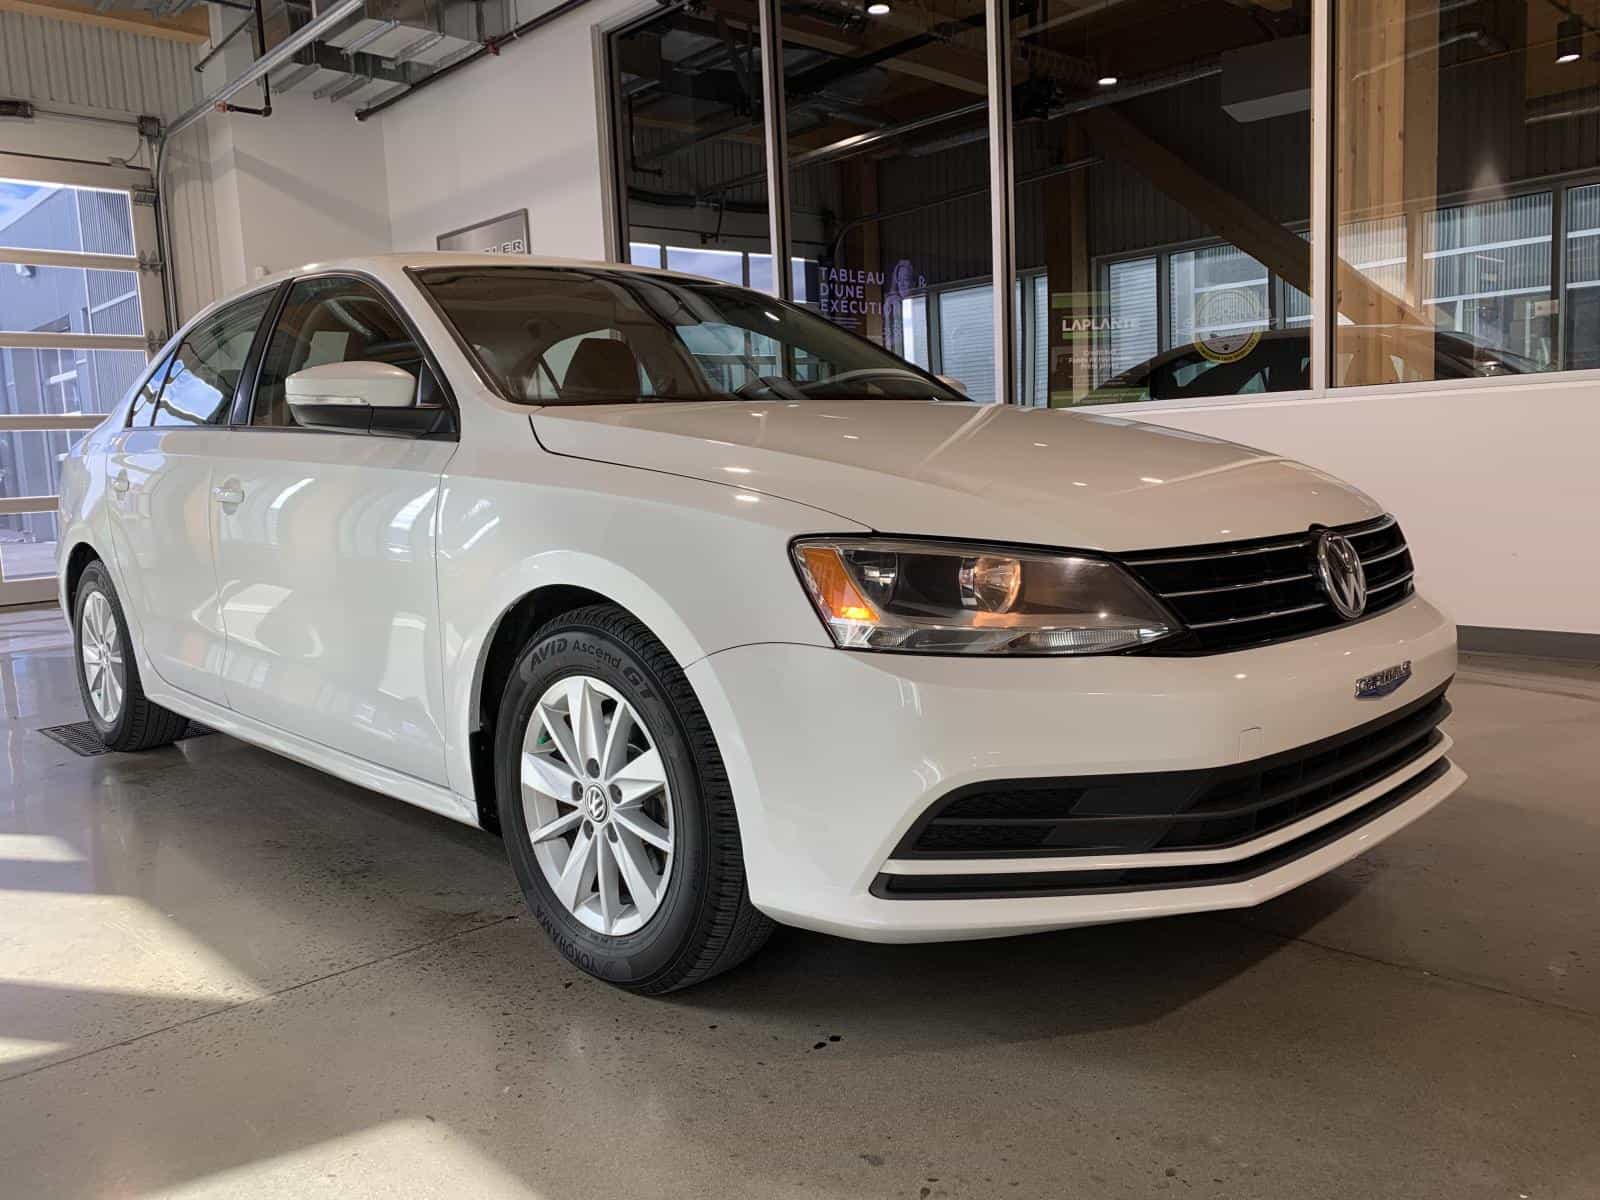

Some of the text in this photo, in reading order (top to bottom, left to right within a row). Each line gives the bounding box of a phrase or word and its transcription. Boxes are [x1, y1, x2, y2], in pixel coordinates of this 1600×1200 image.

[818, 266, 885, 285] TABLEAU
[820, 282, 864, 299] D'UNE
[529, 637, 658, 702] AVID Ascend GT
